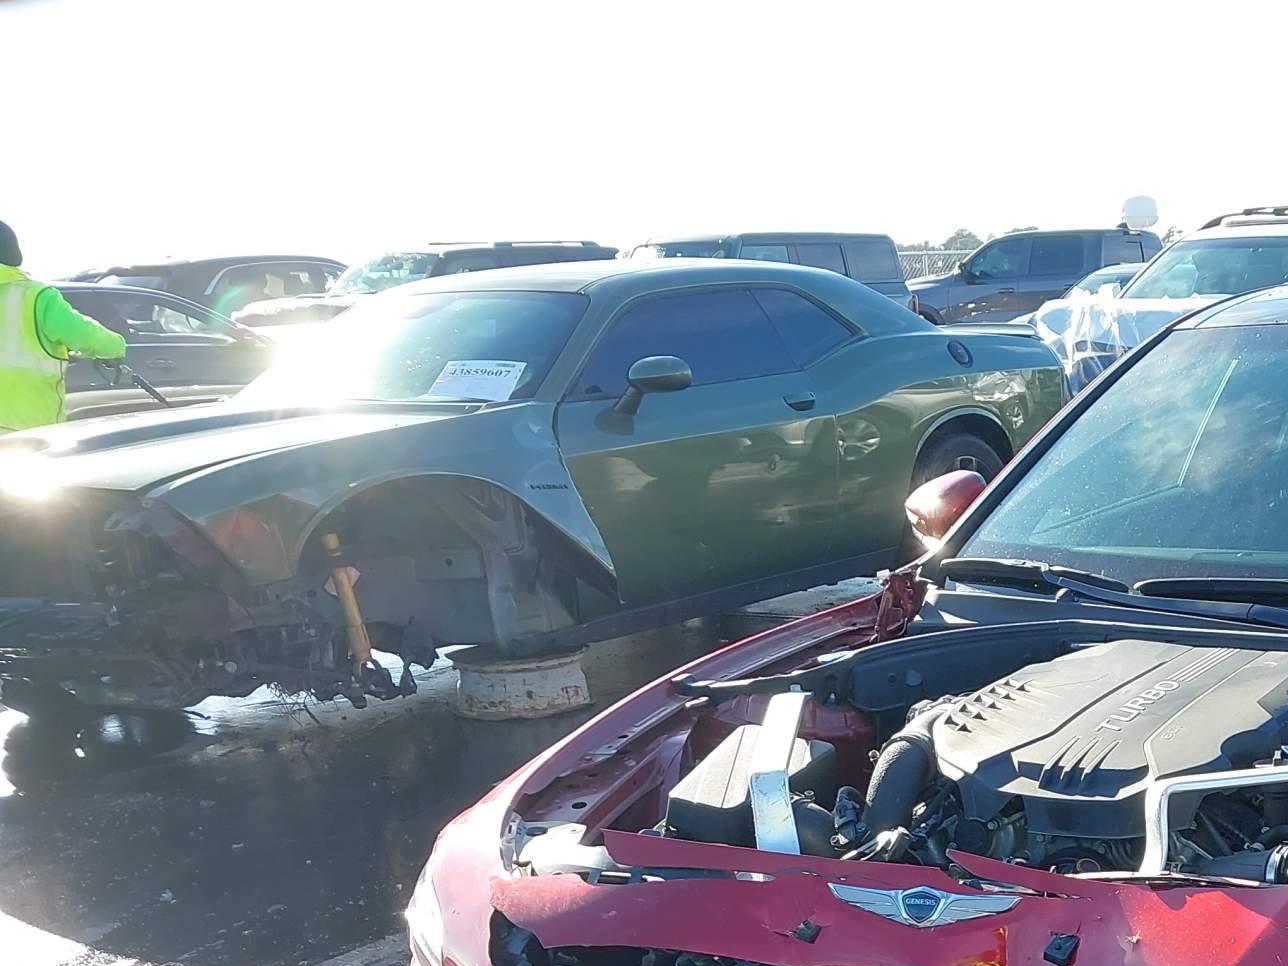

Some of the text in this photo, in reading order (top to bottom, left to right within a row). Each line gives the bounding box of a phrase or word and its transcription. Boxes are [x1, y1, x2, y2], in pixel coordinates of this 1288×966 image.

[449, 368, 512, 378] 43859607
[1095, 680, 1181, 732] TURBO
[905, 897, 936, 906] GENESIS
